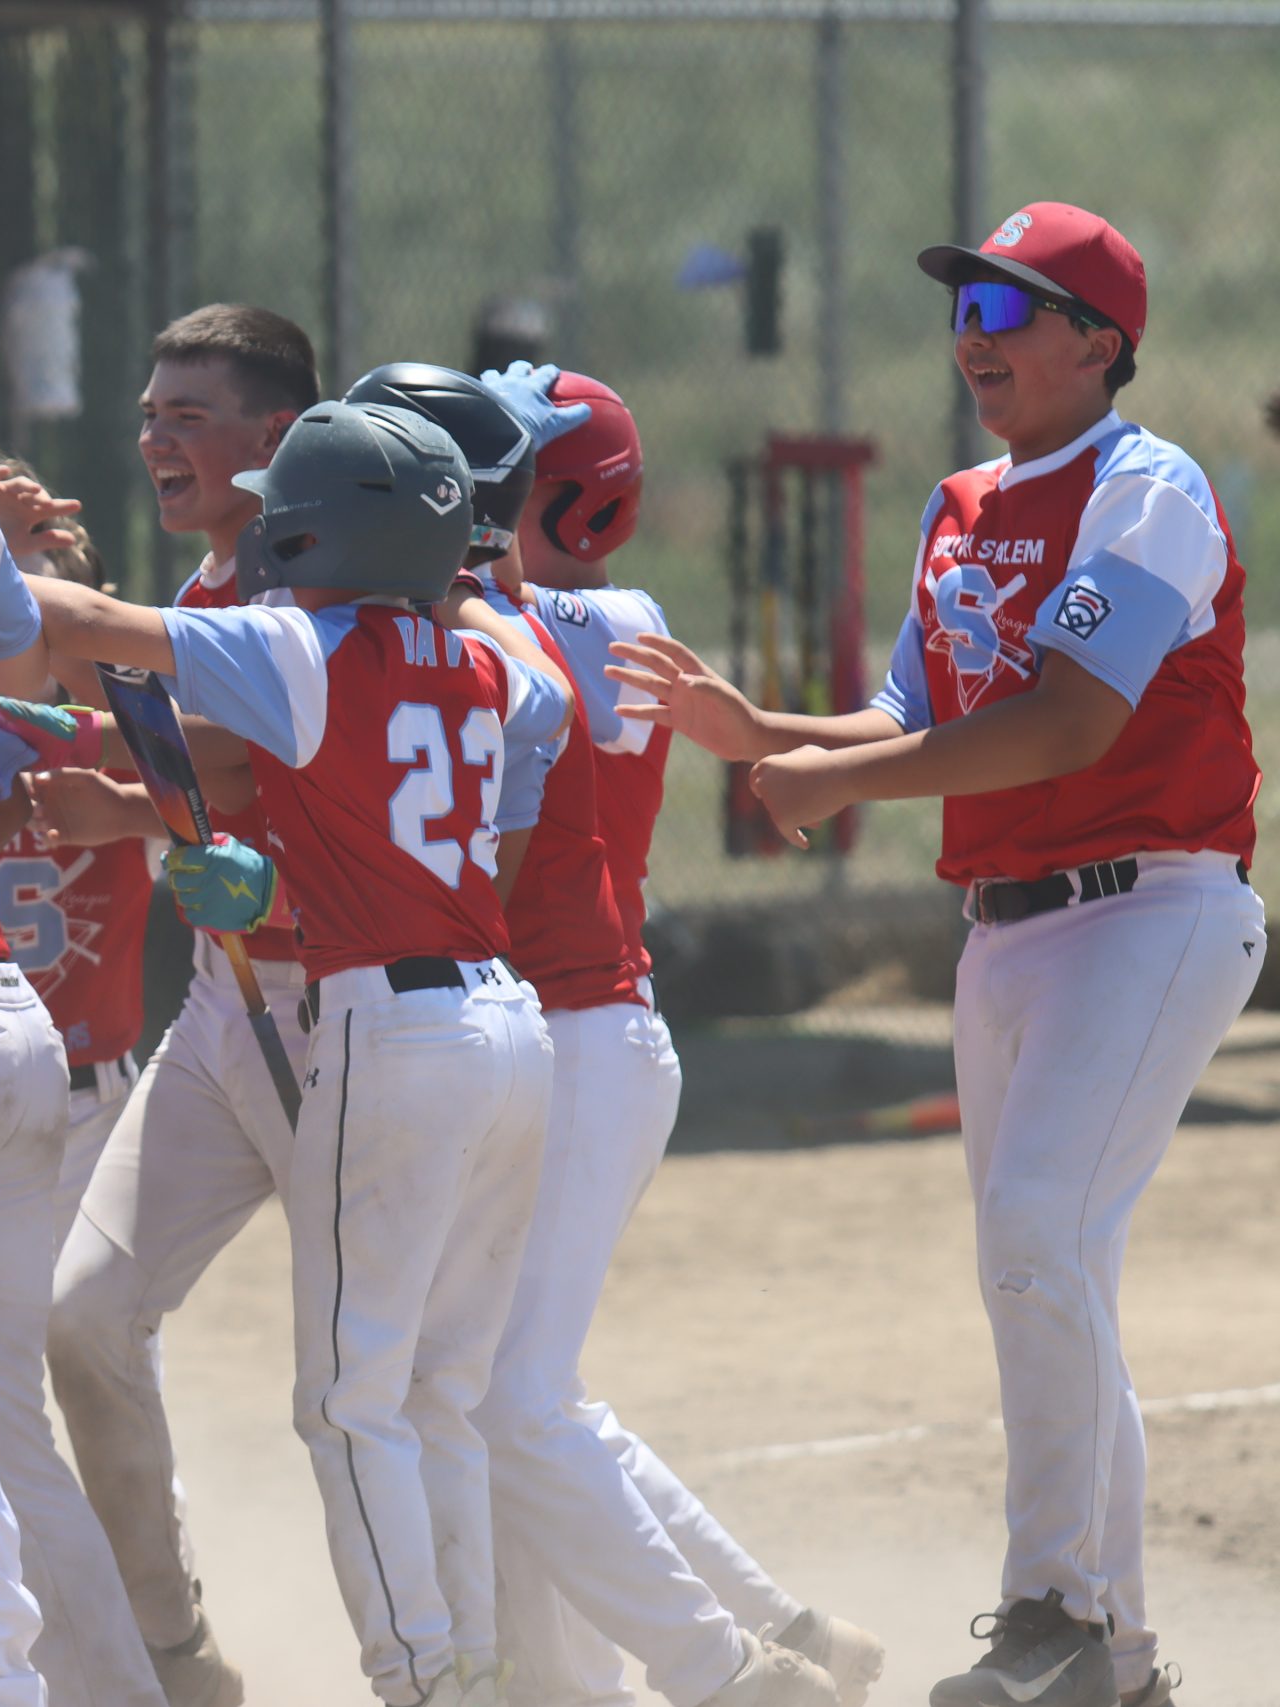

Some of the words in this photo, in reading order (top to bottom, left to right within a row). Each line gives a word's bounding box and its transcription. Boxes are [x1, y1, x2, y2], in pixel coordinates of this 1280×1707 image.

[992, 211, 1033, 247] S
[977, 538, 1046, 565] SALEM
[387, 701, 505, 890] 23
